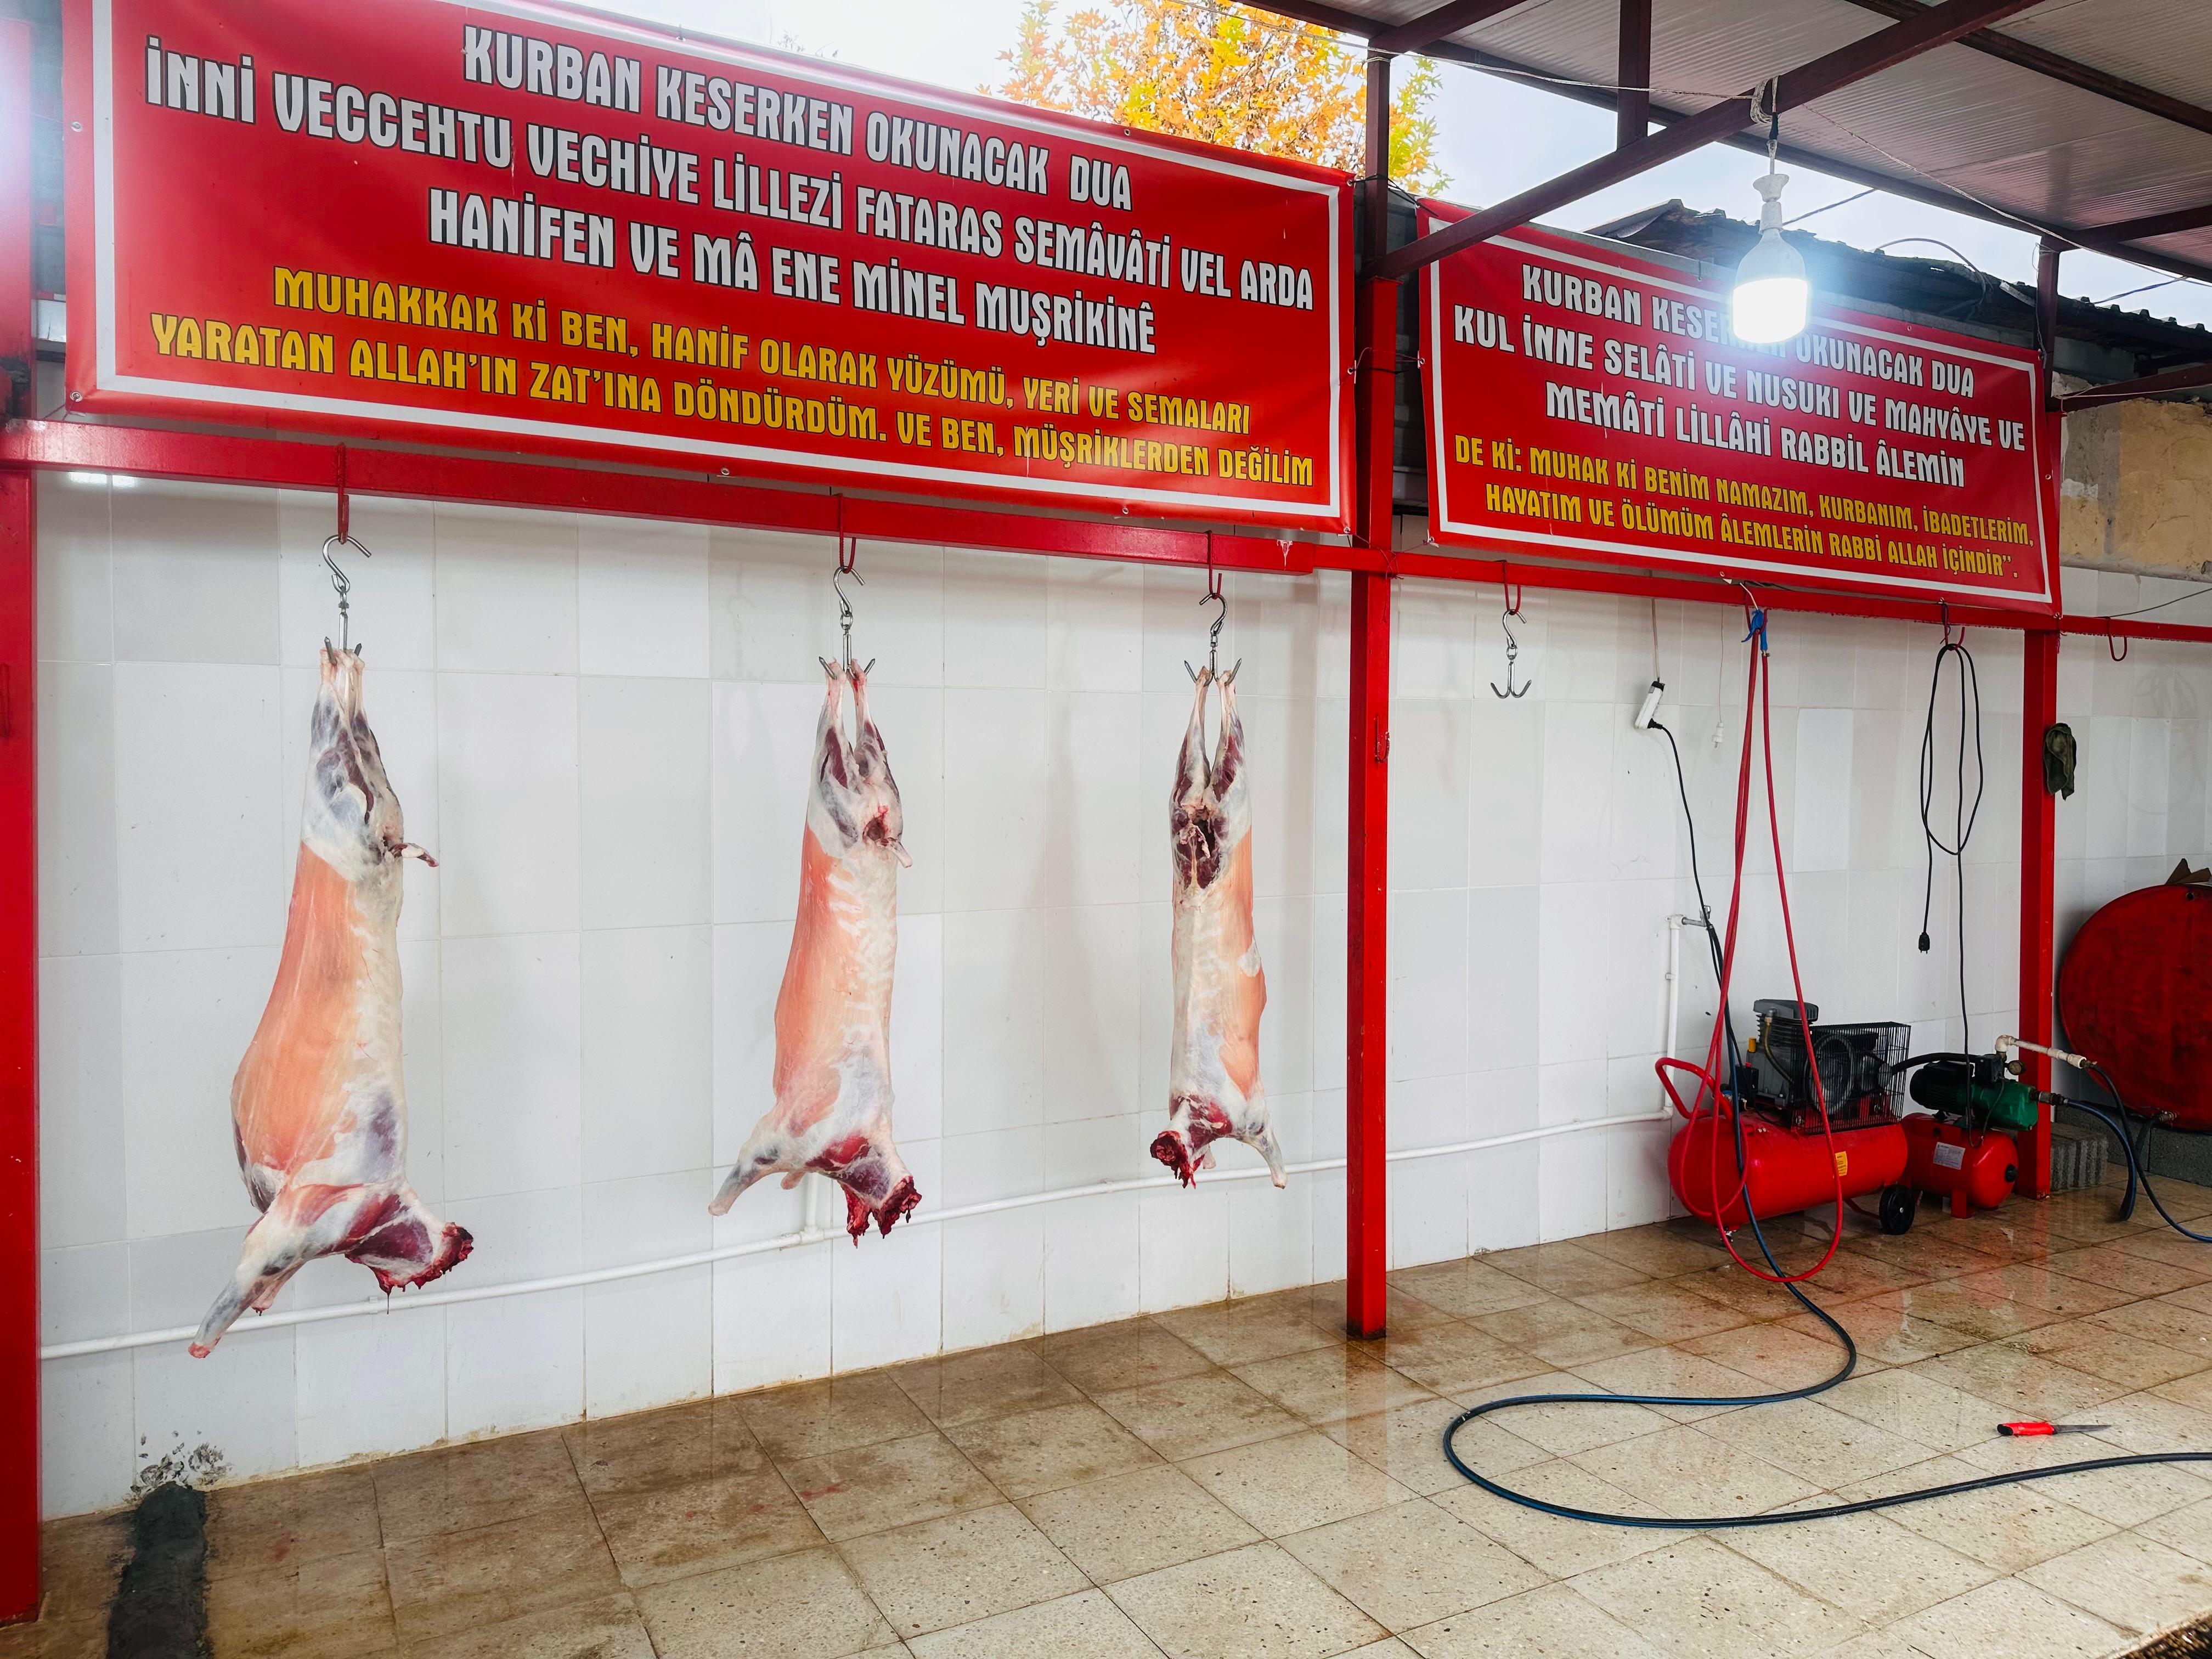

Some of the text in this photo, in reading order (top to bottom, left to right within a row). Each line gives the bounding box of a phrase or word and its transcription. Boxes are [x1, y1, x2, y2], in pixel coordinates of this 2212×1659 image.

[142, 35, 1314, 311] İNNİ VECCEHTU VECHİYE LİLLEZİ FATARAS SEMÂVÂTİ VEL ARDA
[461, 25, 1132, 212] KURBAN KESERKEN OKUNACAK DUA
[430, 187, 1156, 354] HANİFEN VE MÂ ENE MİNEL MUŞRİKİNÊ
[1521, 263, 1975, 399] KURBAN KESER OKUNACAK DUA
[147, 312, 334, 375] YARATAN
[673, 377, 888, 442] DÖNDÜRDÜM.
[896, 410, 932, 448] VE
[940, 416, 1005, 458] BEN,
[1013, 422, 1210, 477] MÜŞRİKLERDEN
[1217, 445, 1313, 487] DEĞİLİM
[274, 266, 1251, 435] MUHAKKAK Kİ BEN, HANİF OLARAK YÜZÜMÜ, YERİ VE SEMALARI
[1453, 303, 2026, 452] KUL İNNE SELÂTİ VE NUSUKI VE MAHYÂYE VE
[1454, 433, 2035, 548] DE Kİ: MUHAK Kİ BENİM NAMAZIM, KURBANIM, İBADETLERİM,
[1545, 380, 1965, 488] MEMÂTİ LİLLÂHİ RABBİL ÂLEMİN
[1485, 482, 1583, 523] HAYATIM
[1587, 497, 1616, 528] VE
[1620, 497, 1715, 541] ÖLÜMÜM
[1720, 512, 1825, 555] ÂLEMLERİN
[1827, 532, 1883, 562] RABBİ
[1887, 540, 1939, 569] ALLAH
